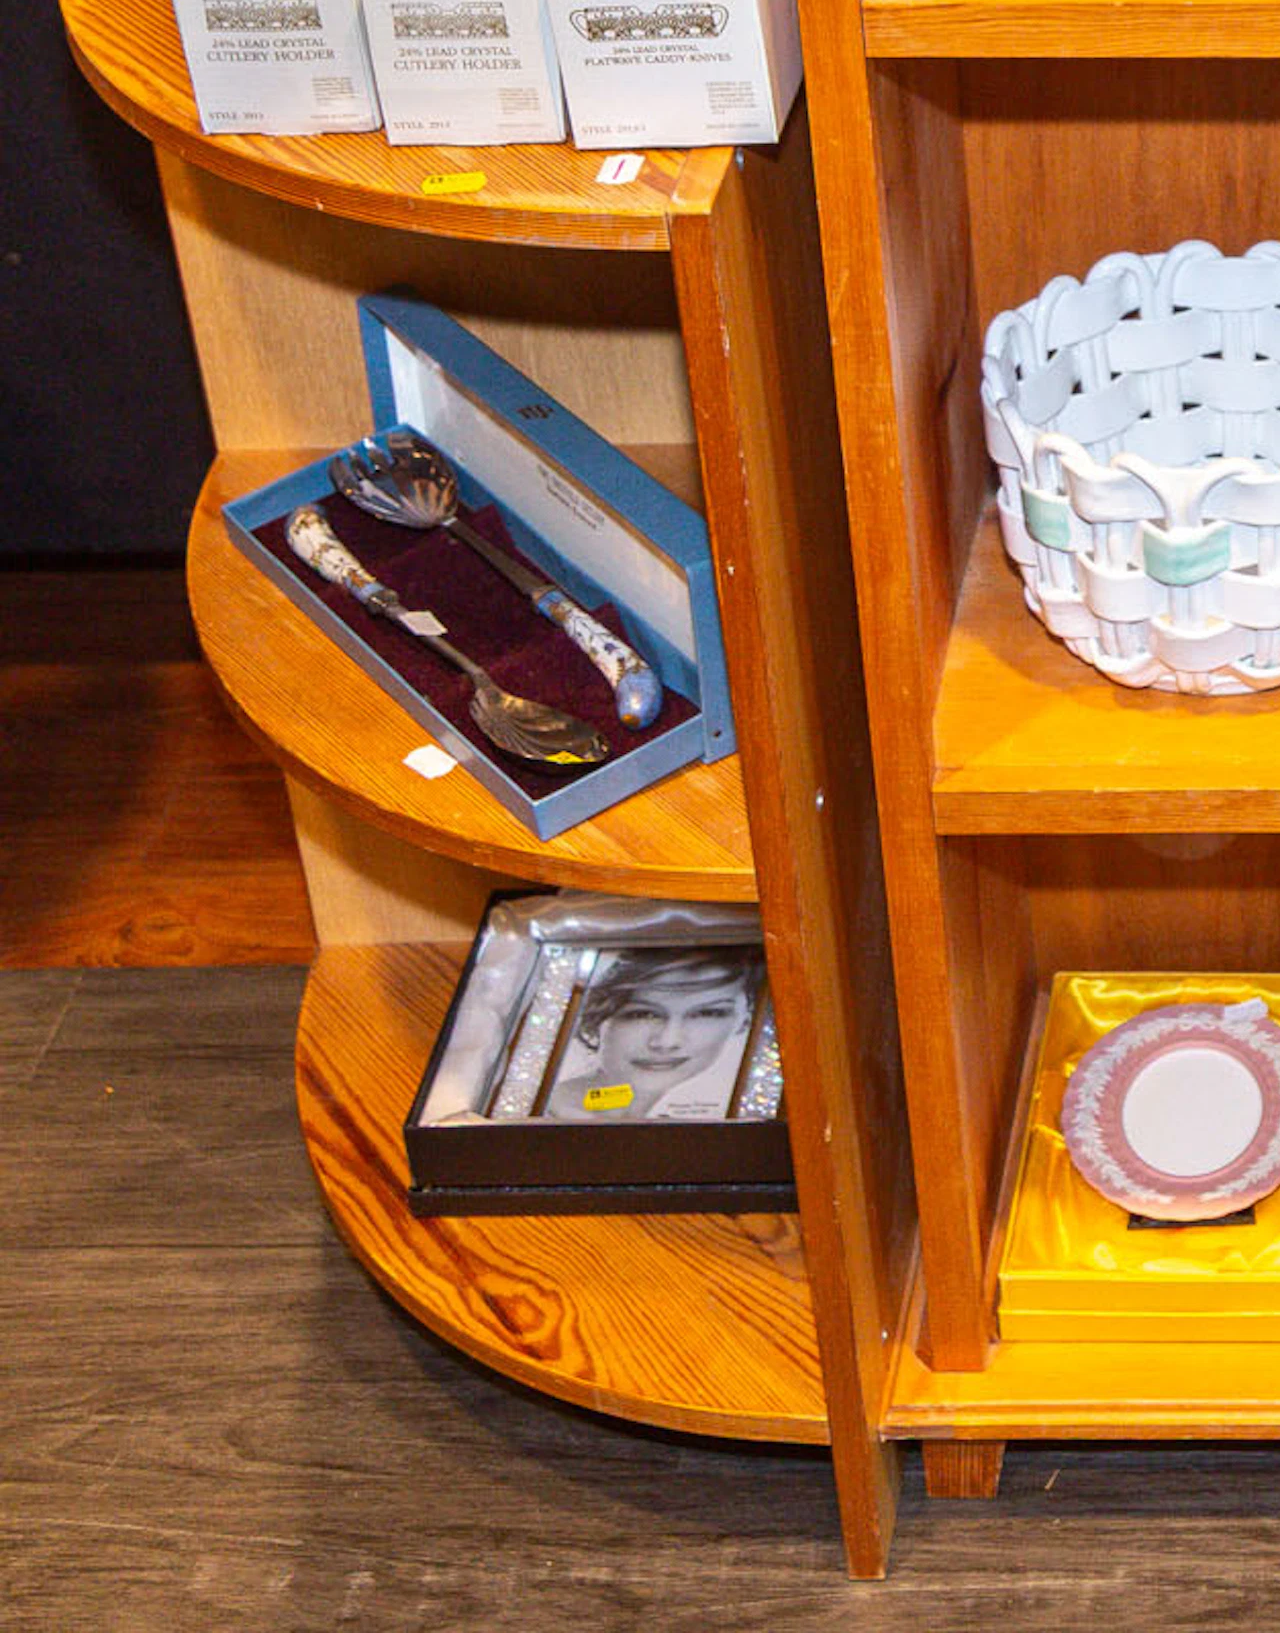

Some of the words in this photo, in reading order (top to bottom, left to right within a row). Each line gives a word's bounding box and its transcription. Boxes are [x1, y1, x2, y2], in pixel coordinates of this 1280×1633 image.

[238, 38, 270, 48] LEAD
[272, 38, 326, 48] CRYSTAL
[426, 47, 457, 56] LEAD
[461, 46, 512, 56] CRYSTAL
[633, 45, 657, 53] LEAD
[659, 44, 699, 52] CRYSTAL
[206, 51, 269, 62] CUTLERY
[274, 49, 335, 61] HOLDER
[393, 60, 457, 70] CUTLERY
[463, 59, 522, 70] HOLDER
